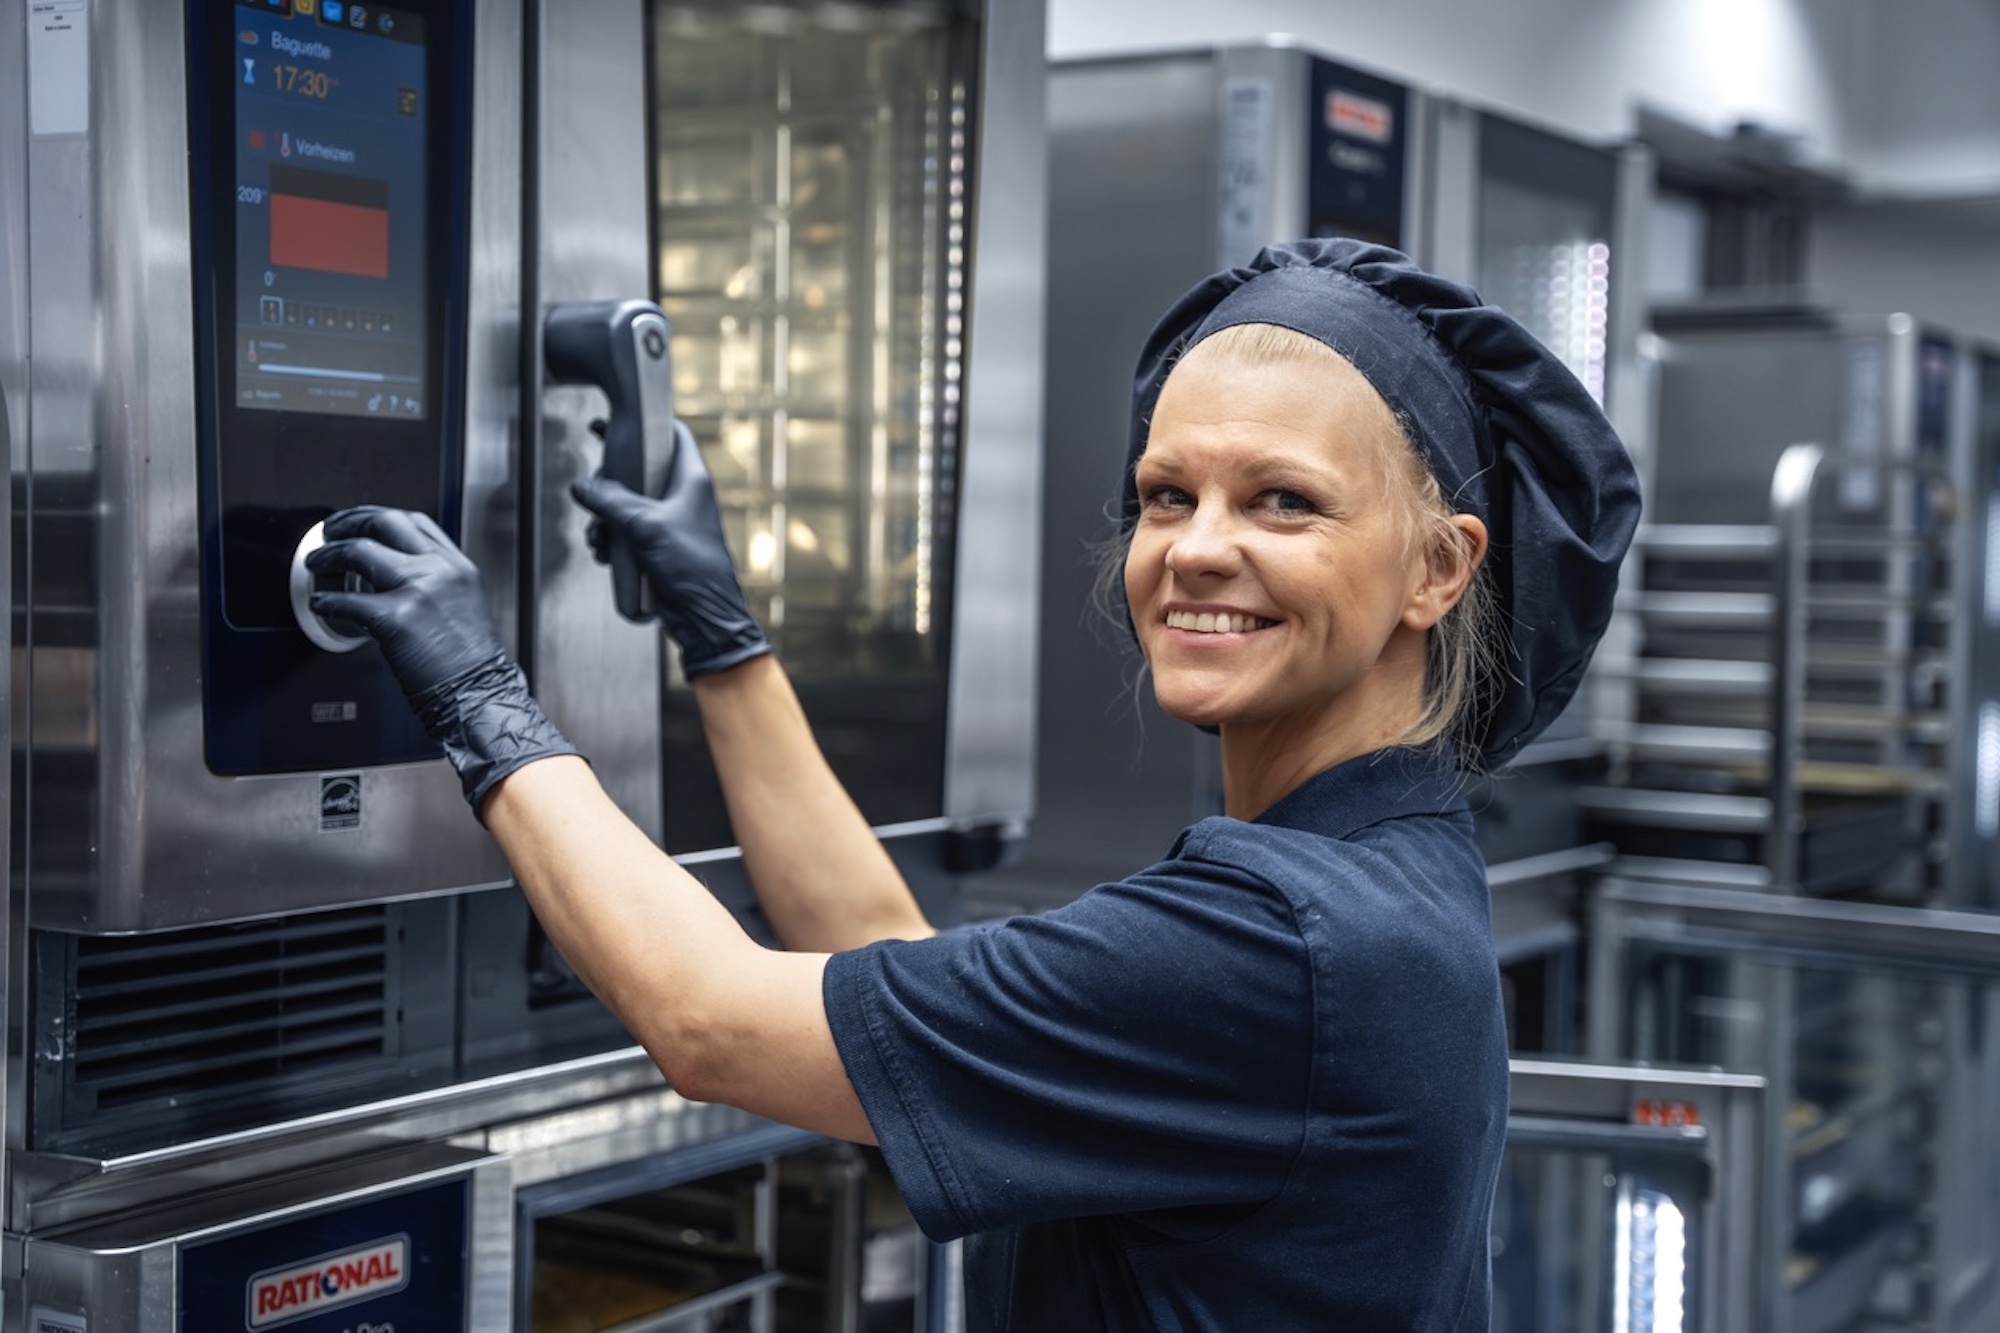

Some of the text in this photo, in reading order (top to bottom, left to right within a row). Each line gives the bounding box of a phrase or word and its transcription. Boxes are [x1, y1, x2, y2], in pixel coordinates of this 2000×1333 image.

[271, 30, 332, 60] Baguette
[273, 64, 329, 99] 17:30
[295, 137, 355, 162] Vorheizen
[258, 1251, 398, 1316] RATIONAL
